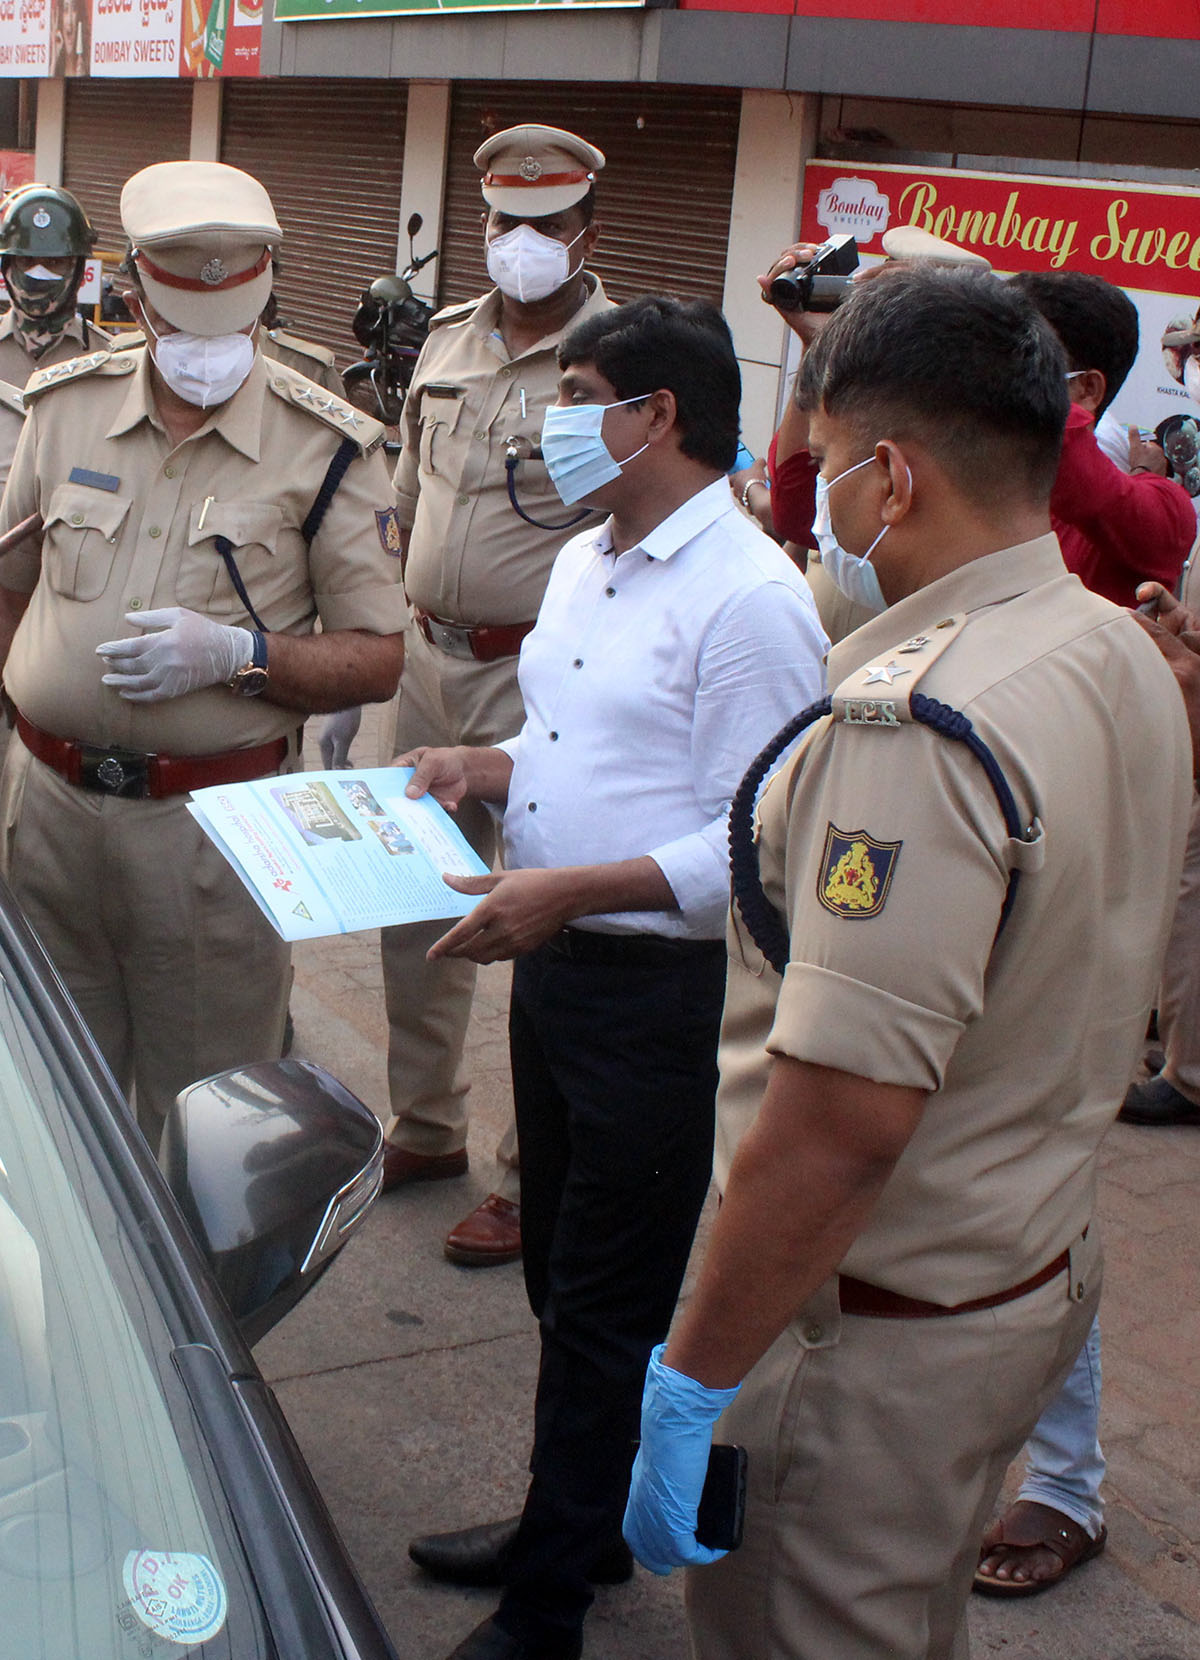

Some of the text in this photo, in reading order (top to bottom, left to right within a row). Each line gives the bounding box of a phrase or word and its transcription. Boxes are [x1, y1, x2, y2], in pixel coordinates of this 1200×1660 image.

[15, 44, 46, 64] SWEETS
[94, 40, 131, 63] BOMBAY
[133, 38, 175, 62] SWEETS
[825, 192, 884, 221] Bombay
[898, 181, 1079, 269] Bombay
[167, 1573, 190, 1599] OK
